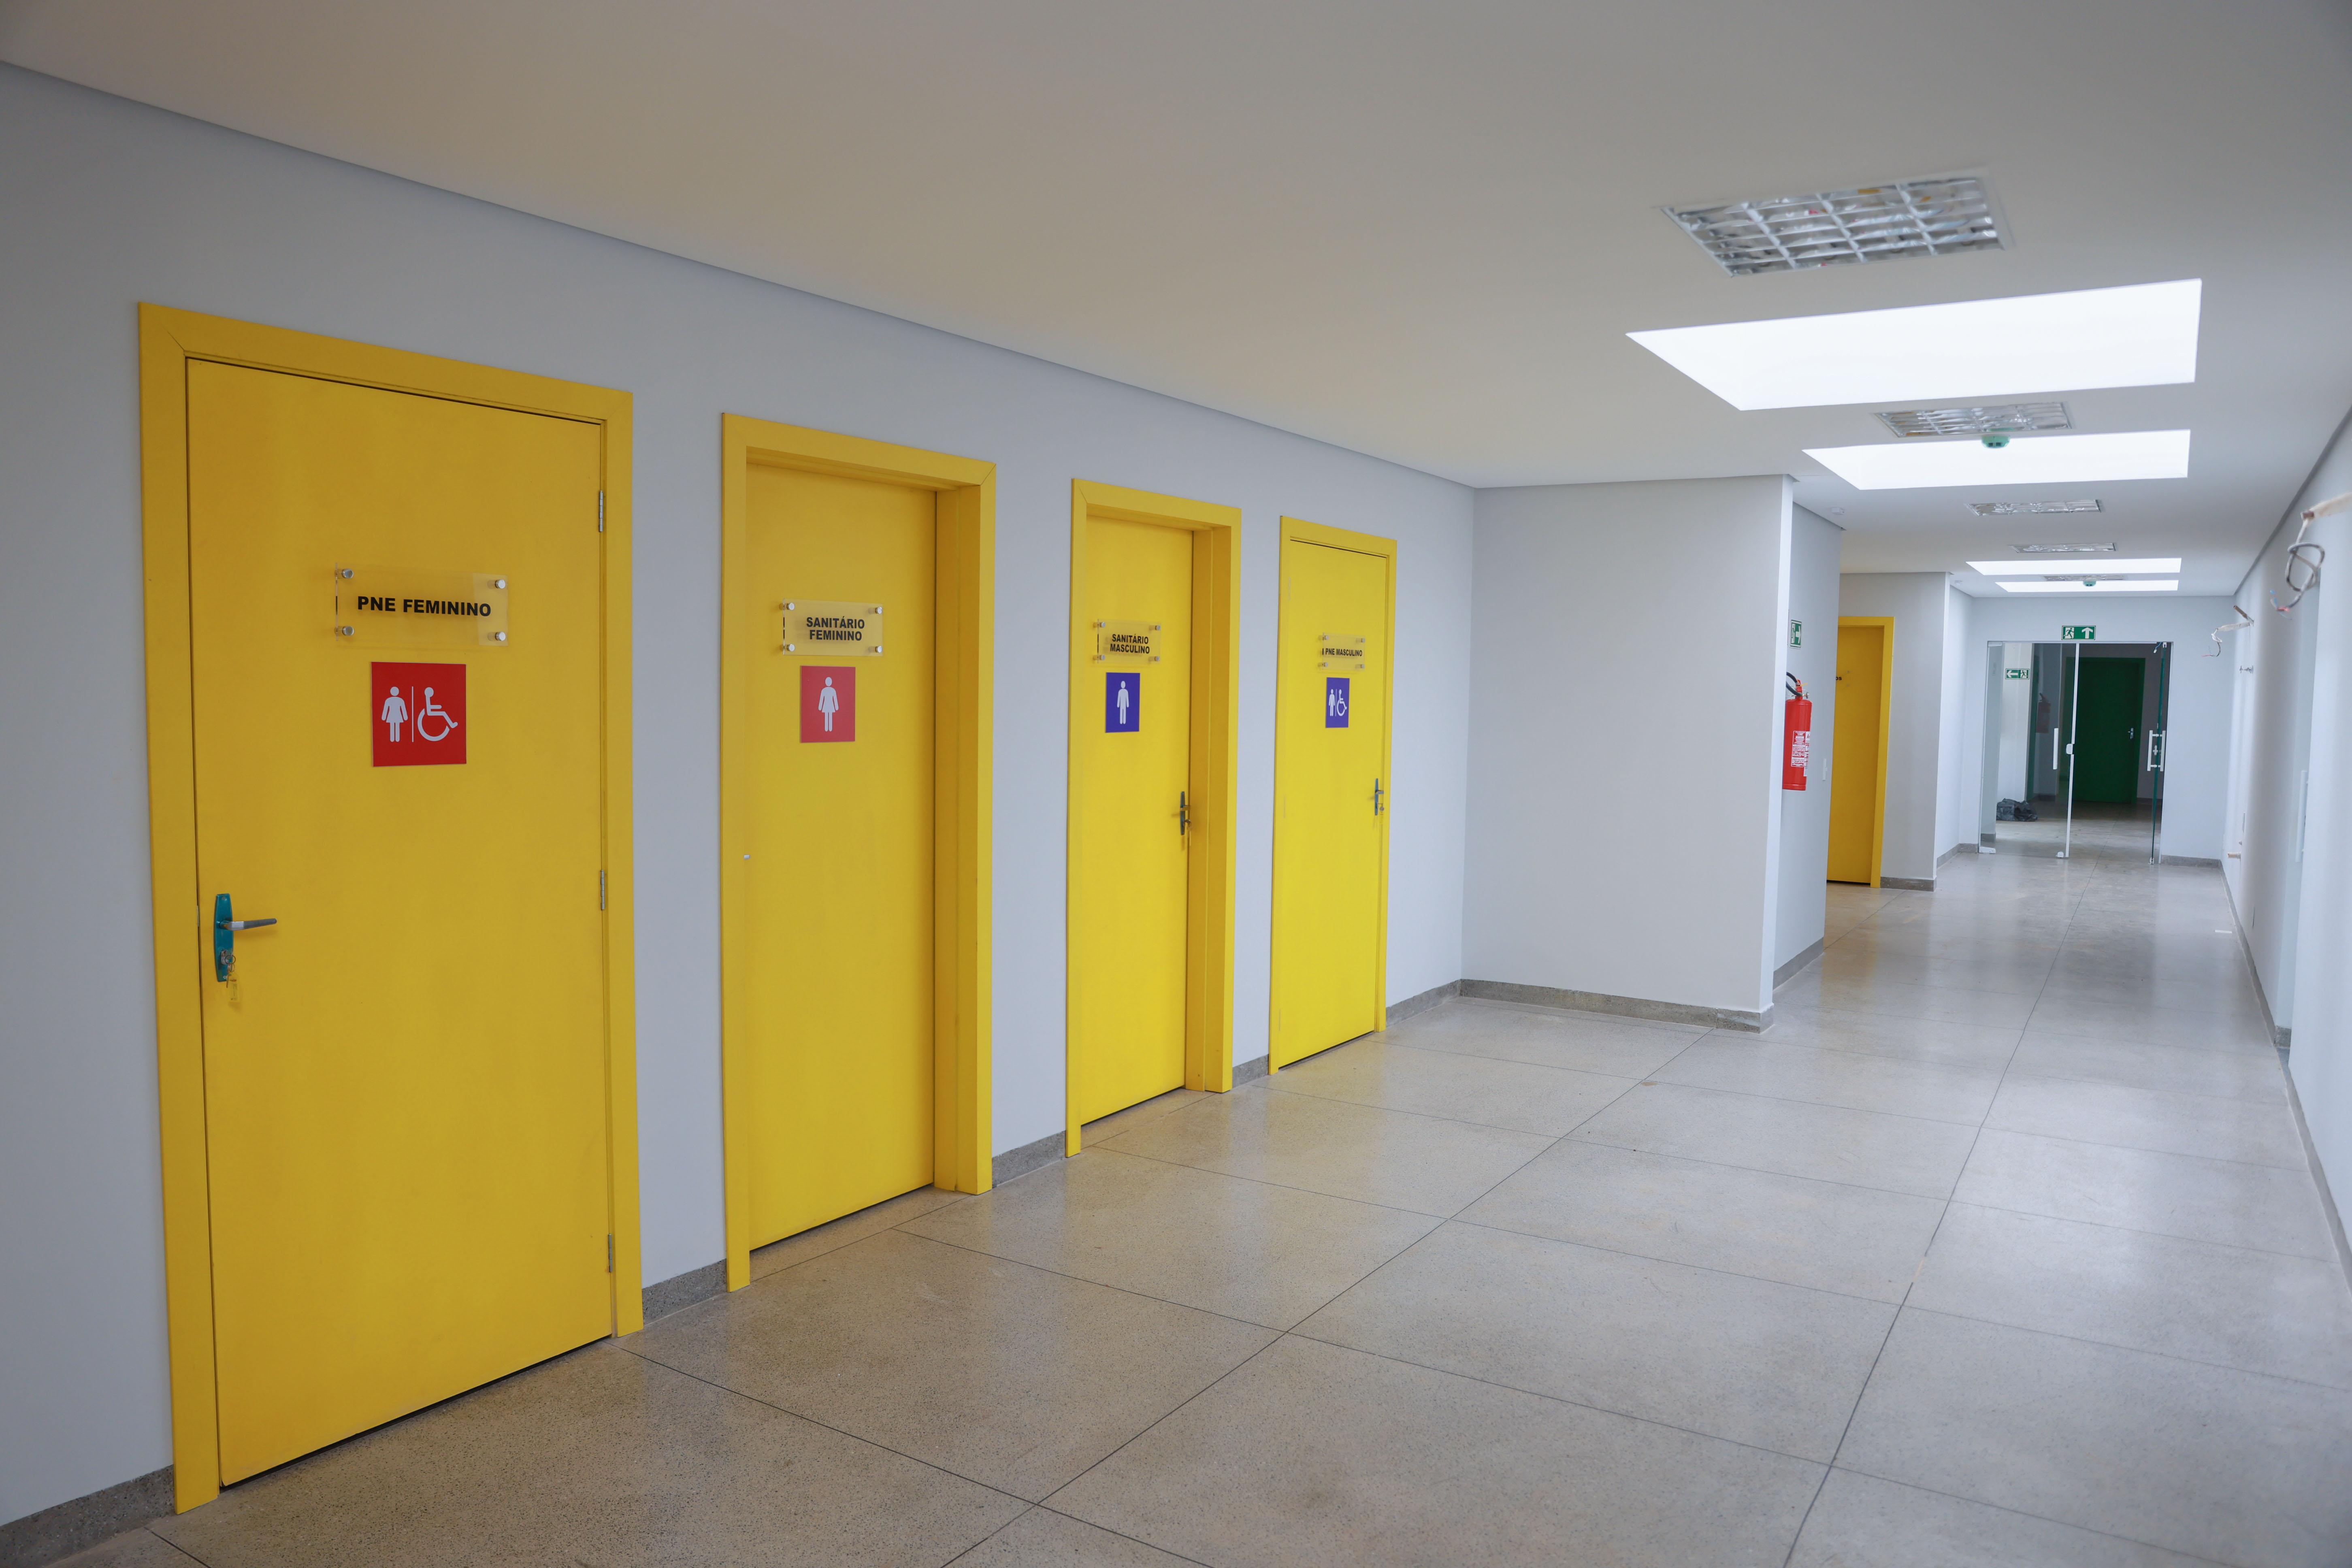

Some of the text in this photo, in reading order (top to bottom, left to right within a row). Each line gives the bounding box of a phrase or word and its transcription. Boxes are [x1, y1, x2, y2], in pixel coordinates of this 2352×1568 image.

[358, 596, 491, 616] PNE FEMININO
[806, 616, 865, 629] SANITÁRIO
[810, 630, 862, 641] FEMININO
[1112, 634, 1148, 644] SANITÁRIO
[1110, 643, 1150, 654] MASCULINO
